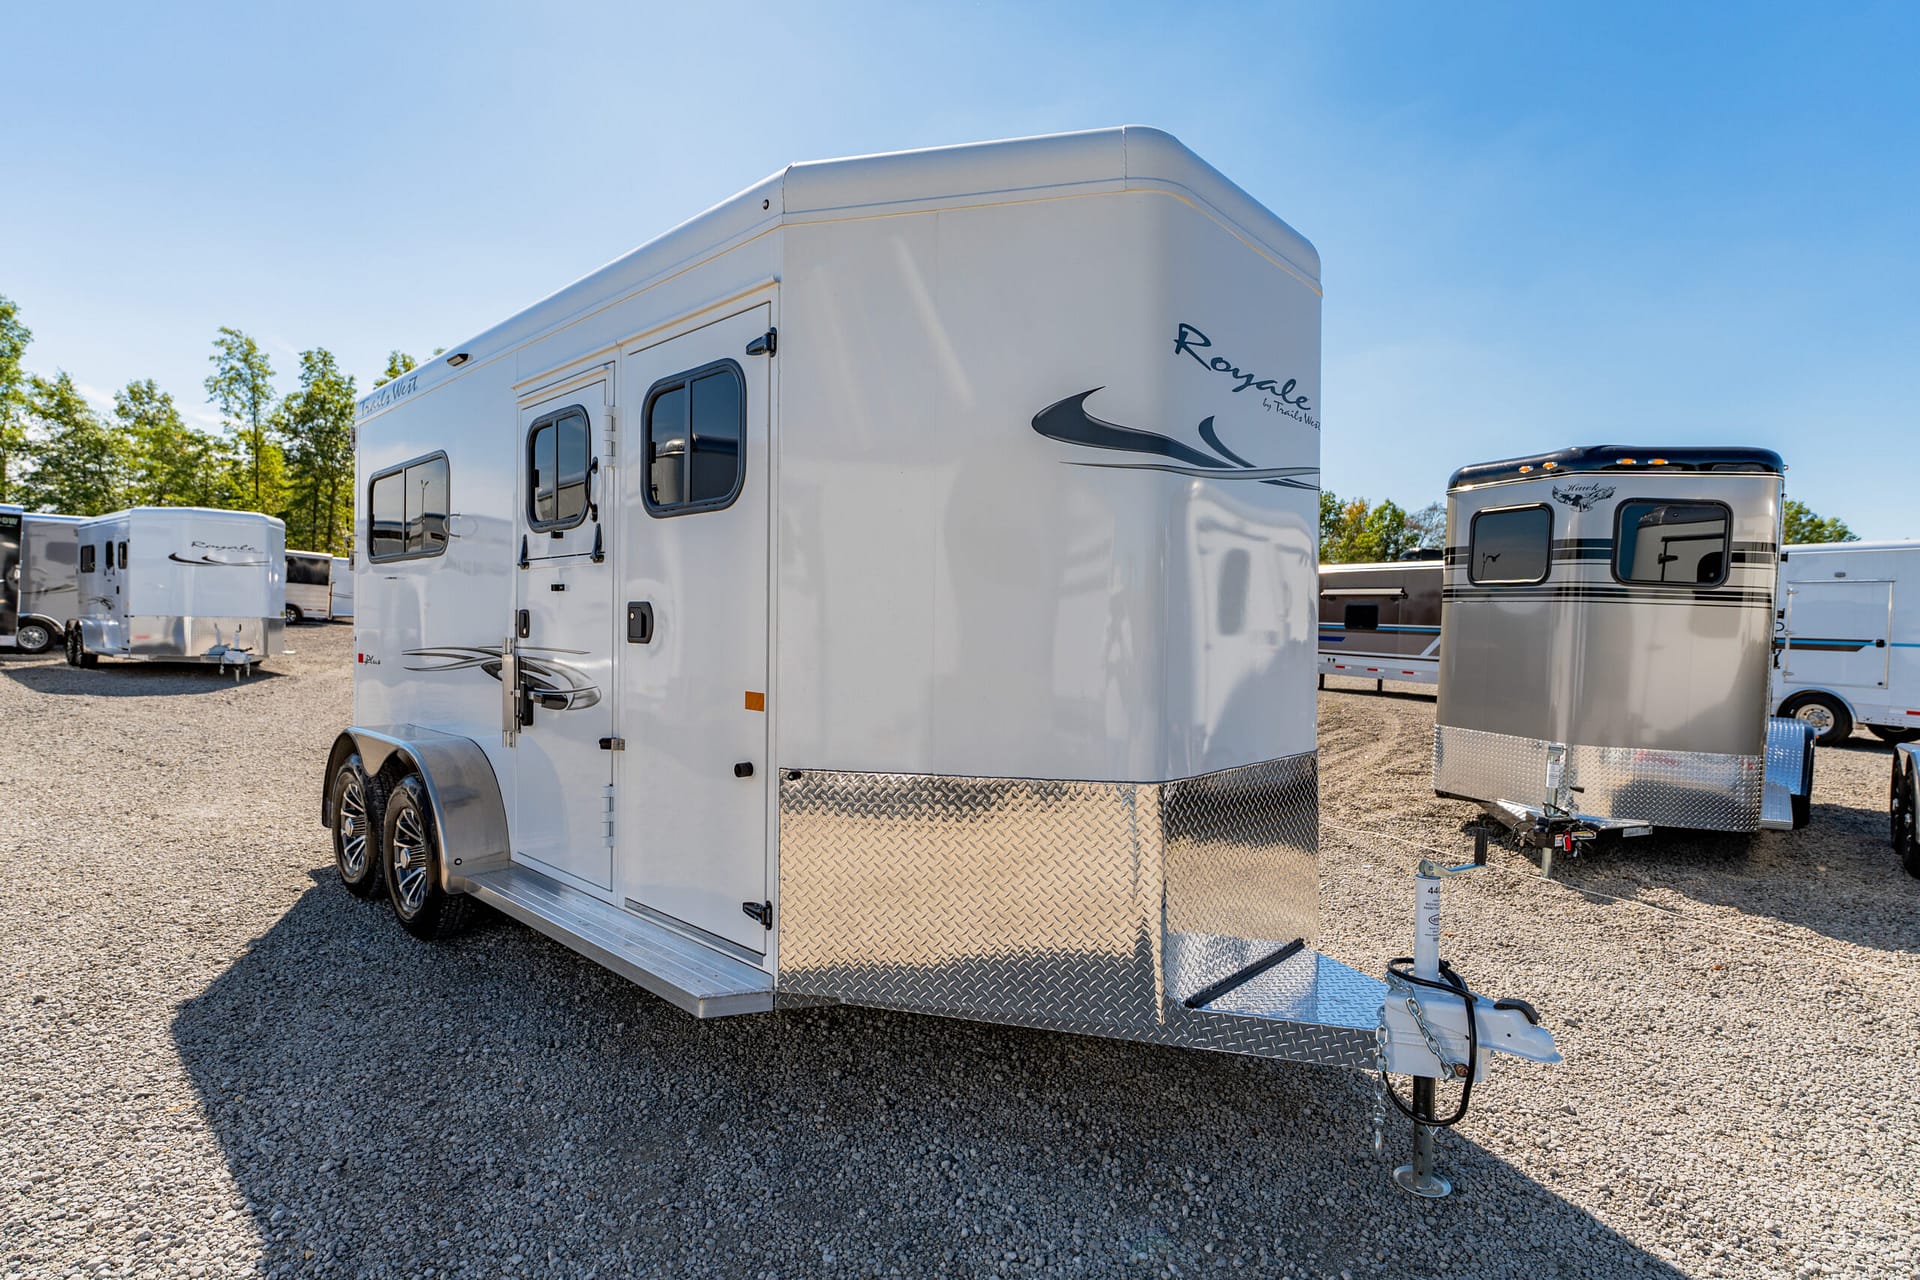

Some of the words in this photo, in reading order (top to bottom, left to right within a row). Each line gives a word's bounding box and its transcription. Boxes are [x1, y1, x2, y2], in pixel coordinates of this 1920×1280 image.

[1174, 323, 1311, 411] Royale
[360, 390, 390, 416] Trails
[392, 376, 418, 400] West
[1262, 397, 1272, 412] by
[1274, 400, 1303, 422] Trails
